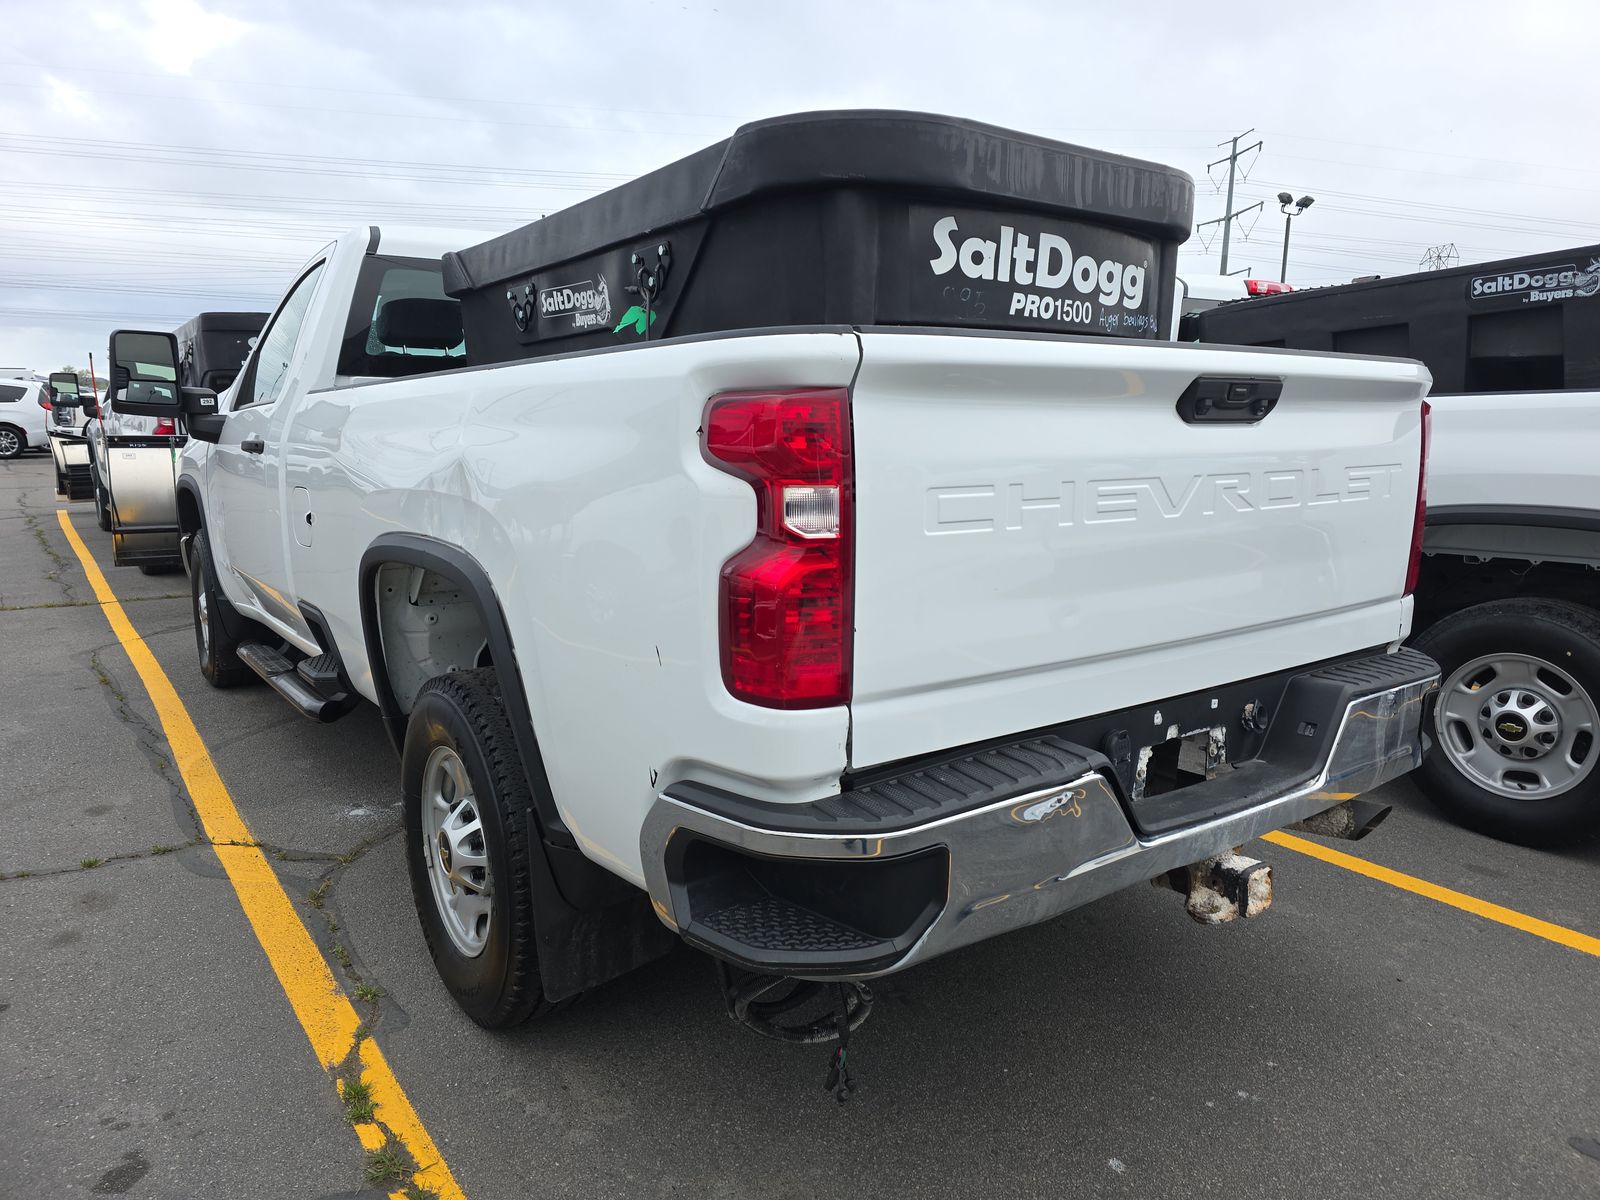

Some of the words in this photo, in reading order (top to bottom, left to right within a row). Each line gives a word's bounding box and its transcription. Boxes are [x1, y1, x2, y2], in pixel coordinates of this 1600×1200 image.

[930, 216, 1145, 309] SaltDogg
[1472, 271, 1574, 296] SaltDogg
[1529, 289, 1574, 302] Buyers
[541, 288, 595, 313] SaltDogg
[575, 313, 597, 328] Buyers
[924, 463, 1403, 536] CHEVROLET
